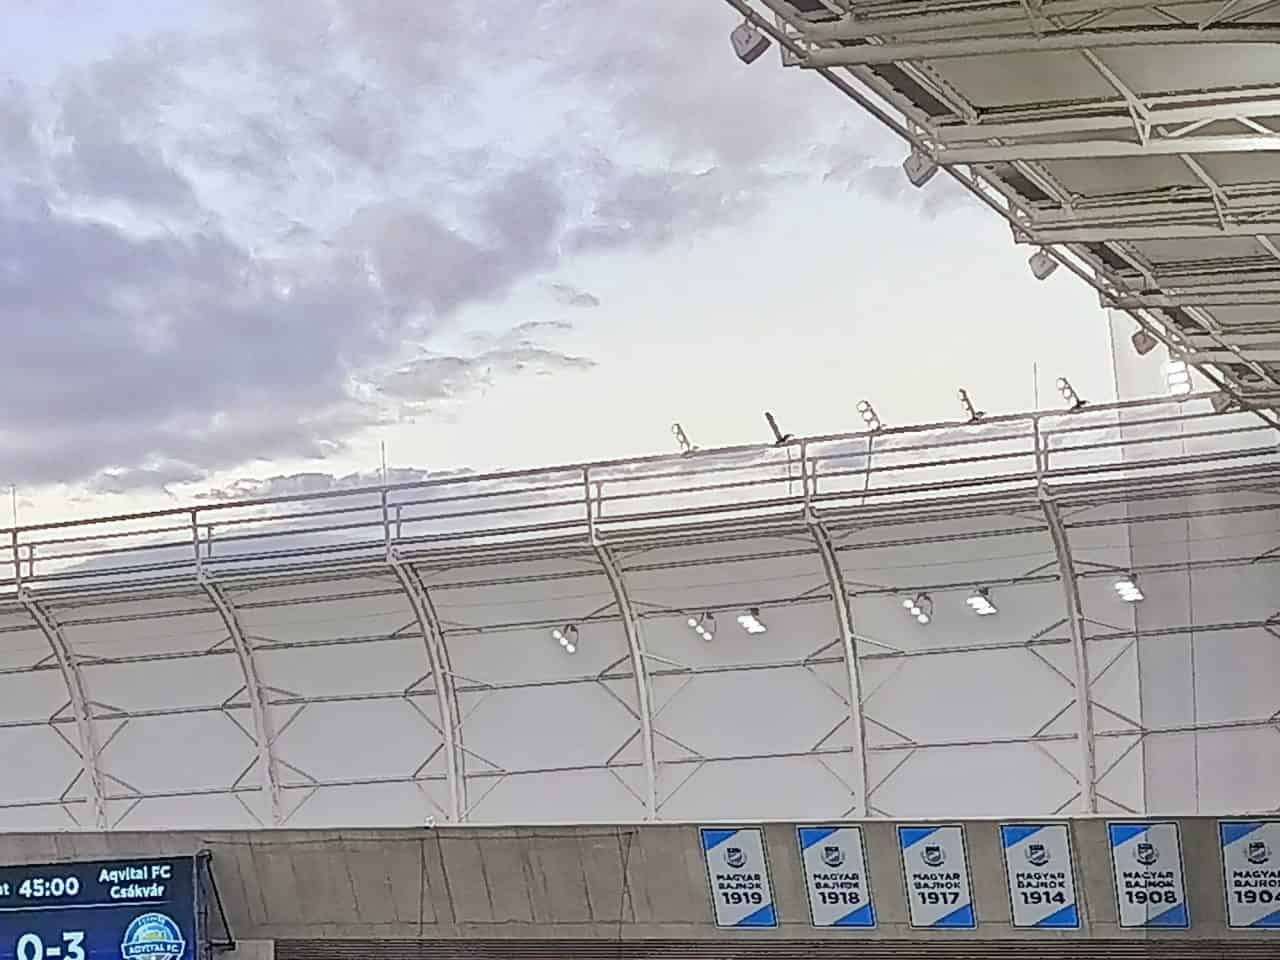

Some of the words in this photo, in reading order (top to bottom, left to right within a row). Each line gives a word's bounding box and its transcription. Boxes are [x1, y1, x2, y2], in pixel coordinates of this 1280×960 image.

[99, 867, 148, 883] Aqvital
[151, 866, 171, 879] FC
[716, 873, 761, 881] MAGYAR
[813, 873, 859, 881] MAGYAR
[1016, 872, 1065, 880] MAGYAR
[1123, 871, 1173, 879] MAGYAR
[1233, 870, 1280, 878] MAGYA
[20, 877, 79, 897] 45:00
[718, 882, 762, 890] BAJNOK
[914, 881, 960, 889] BAJNOK
[1125, 880, 1175, 888] BAJNOK
[1234, 879, 1280, 888] BAJNO
[110, 884, 165, 899] Csákvár
[722, 892, 762, 904] 1919
[818, 891, 860, 904] 1918
[918, 892, 960, 904] 1917
[1020, 891, 1066, 904] 1914
[1125, 891, 1177, 904] 1908
